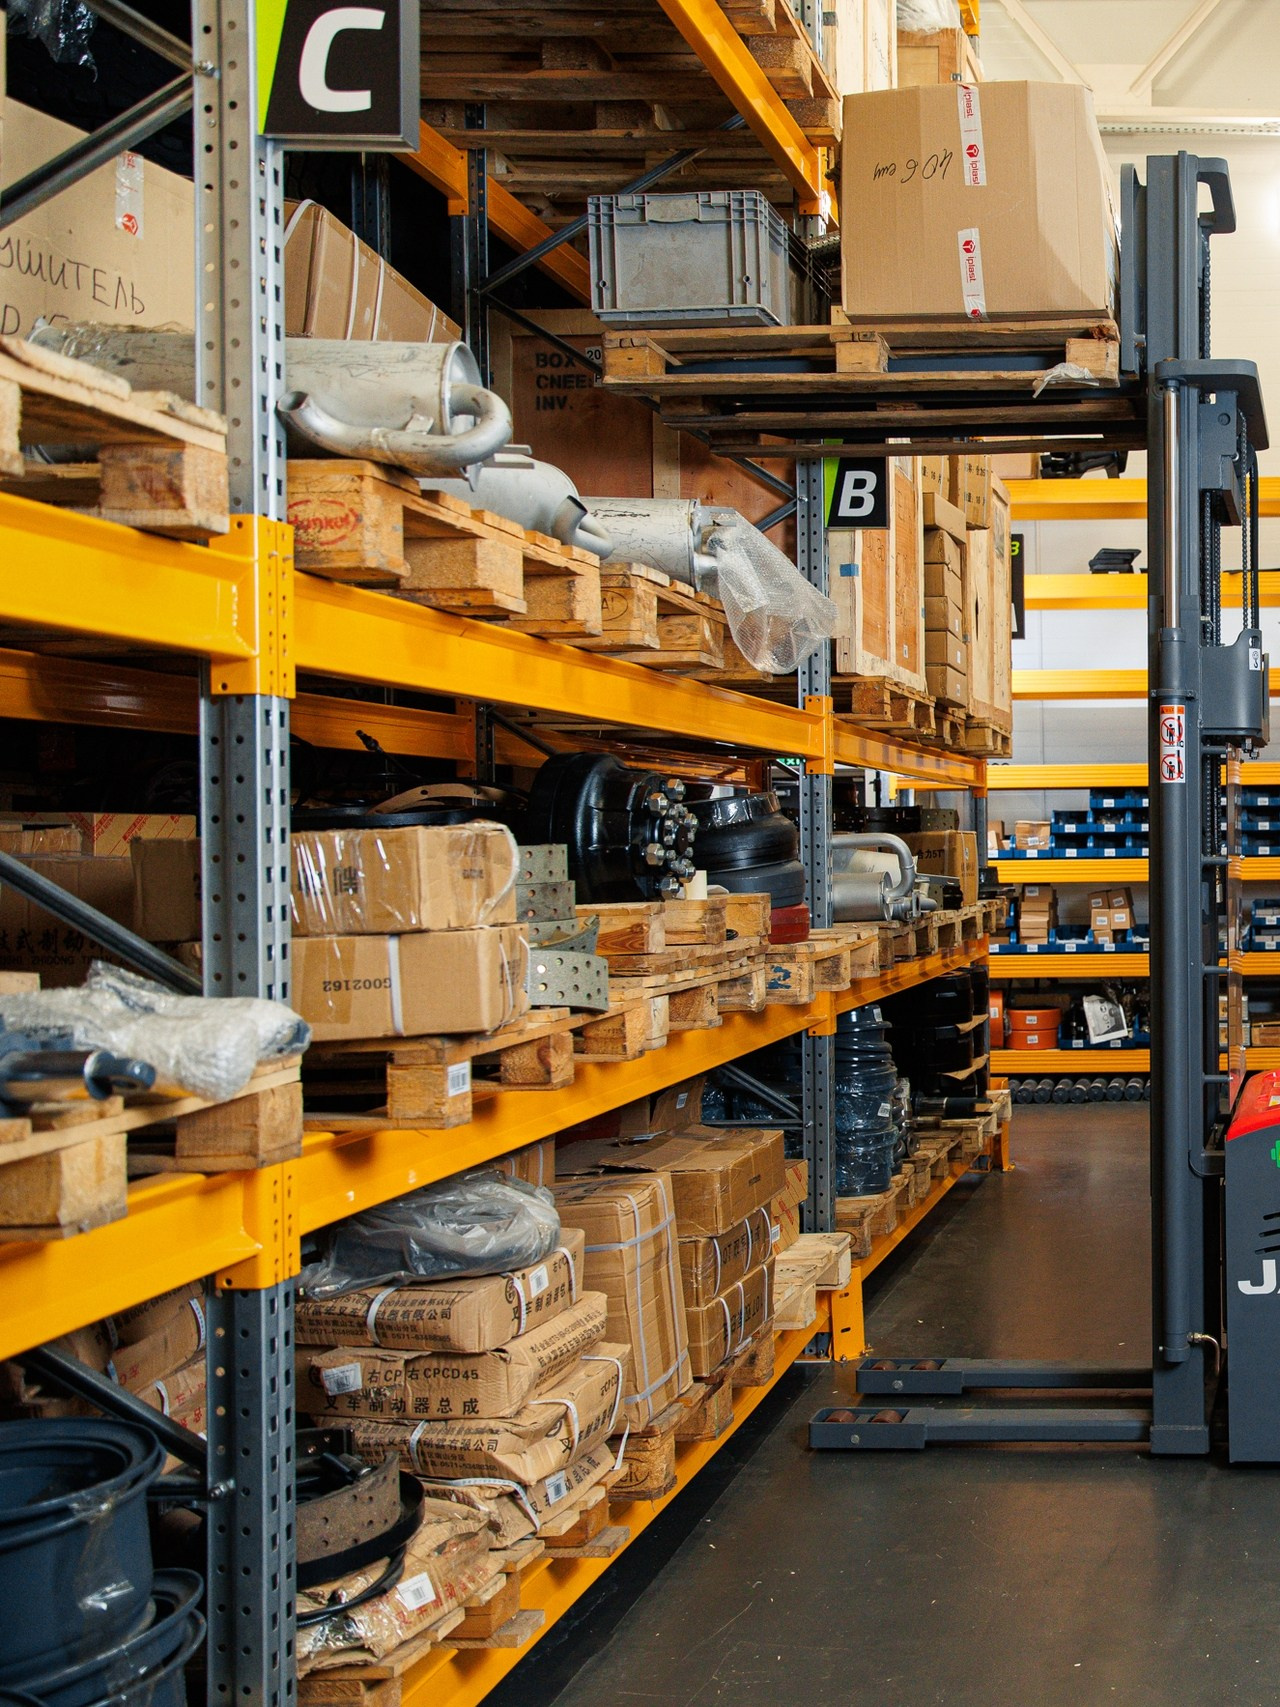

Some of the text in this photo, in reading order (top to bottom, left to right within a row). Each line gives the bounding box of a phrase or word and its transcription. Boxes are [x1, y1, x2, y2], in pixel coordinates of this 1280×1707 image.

[299, 7, 386, 113] C
[963, 90, 974, 119] iplast
[967, 256, 977, 282] iplast
[535, 352, 577, 368] BOX
[535, 395, 574, 411] INV.
[837, 469, 878, 517] B
[322, 977, 392, 992] G002162
